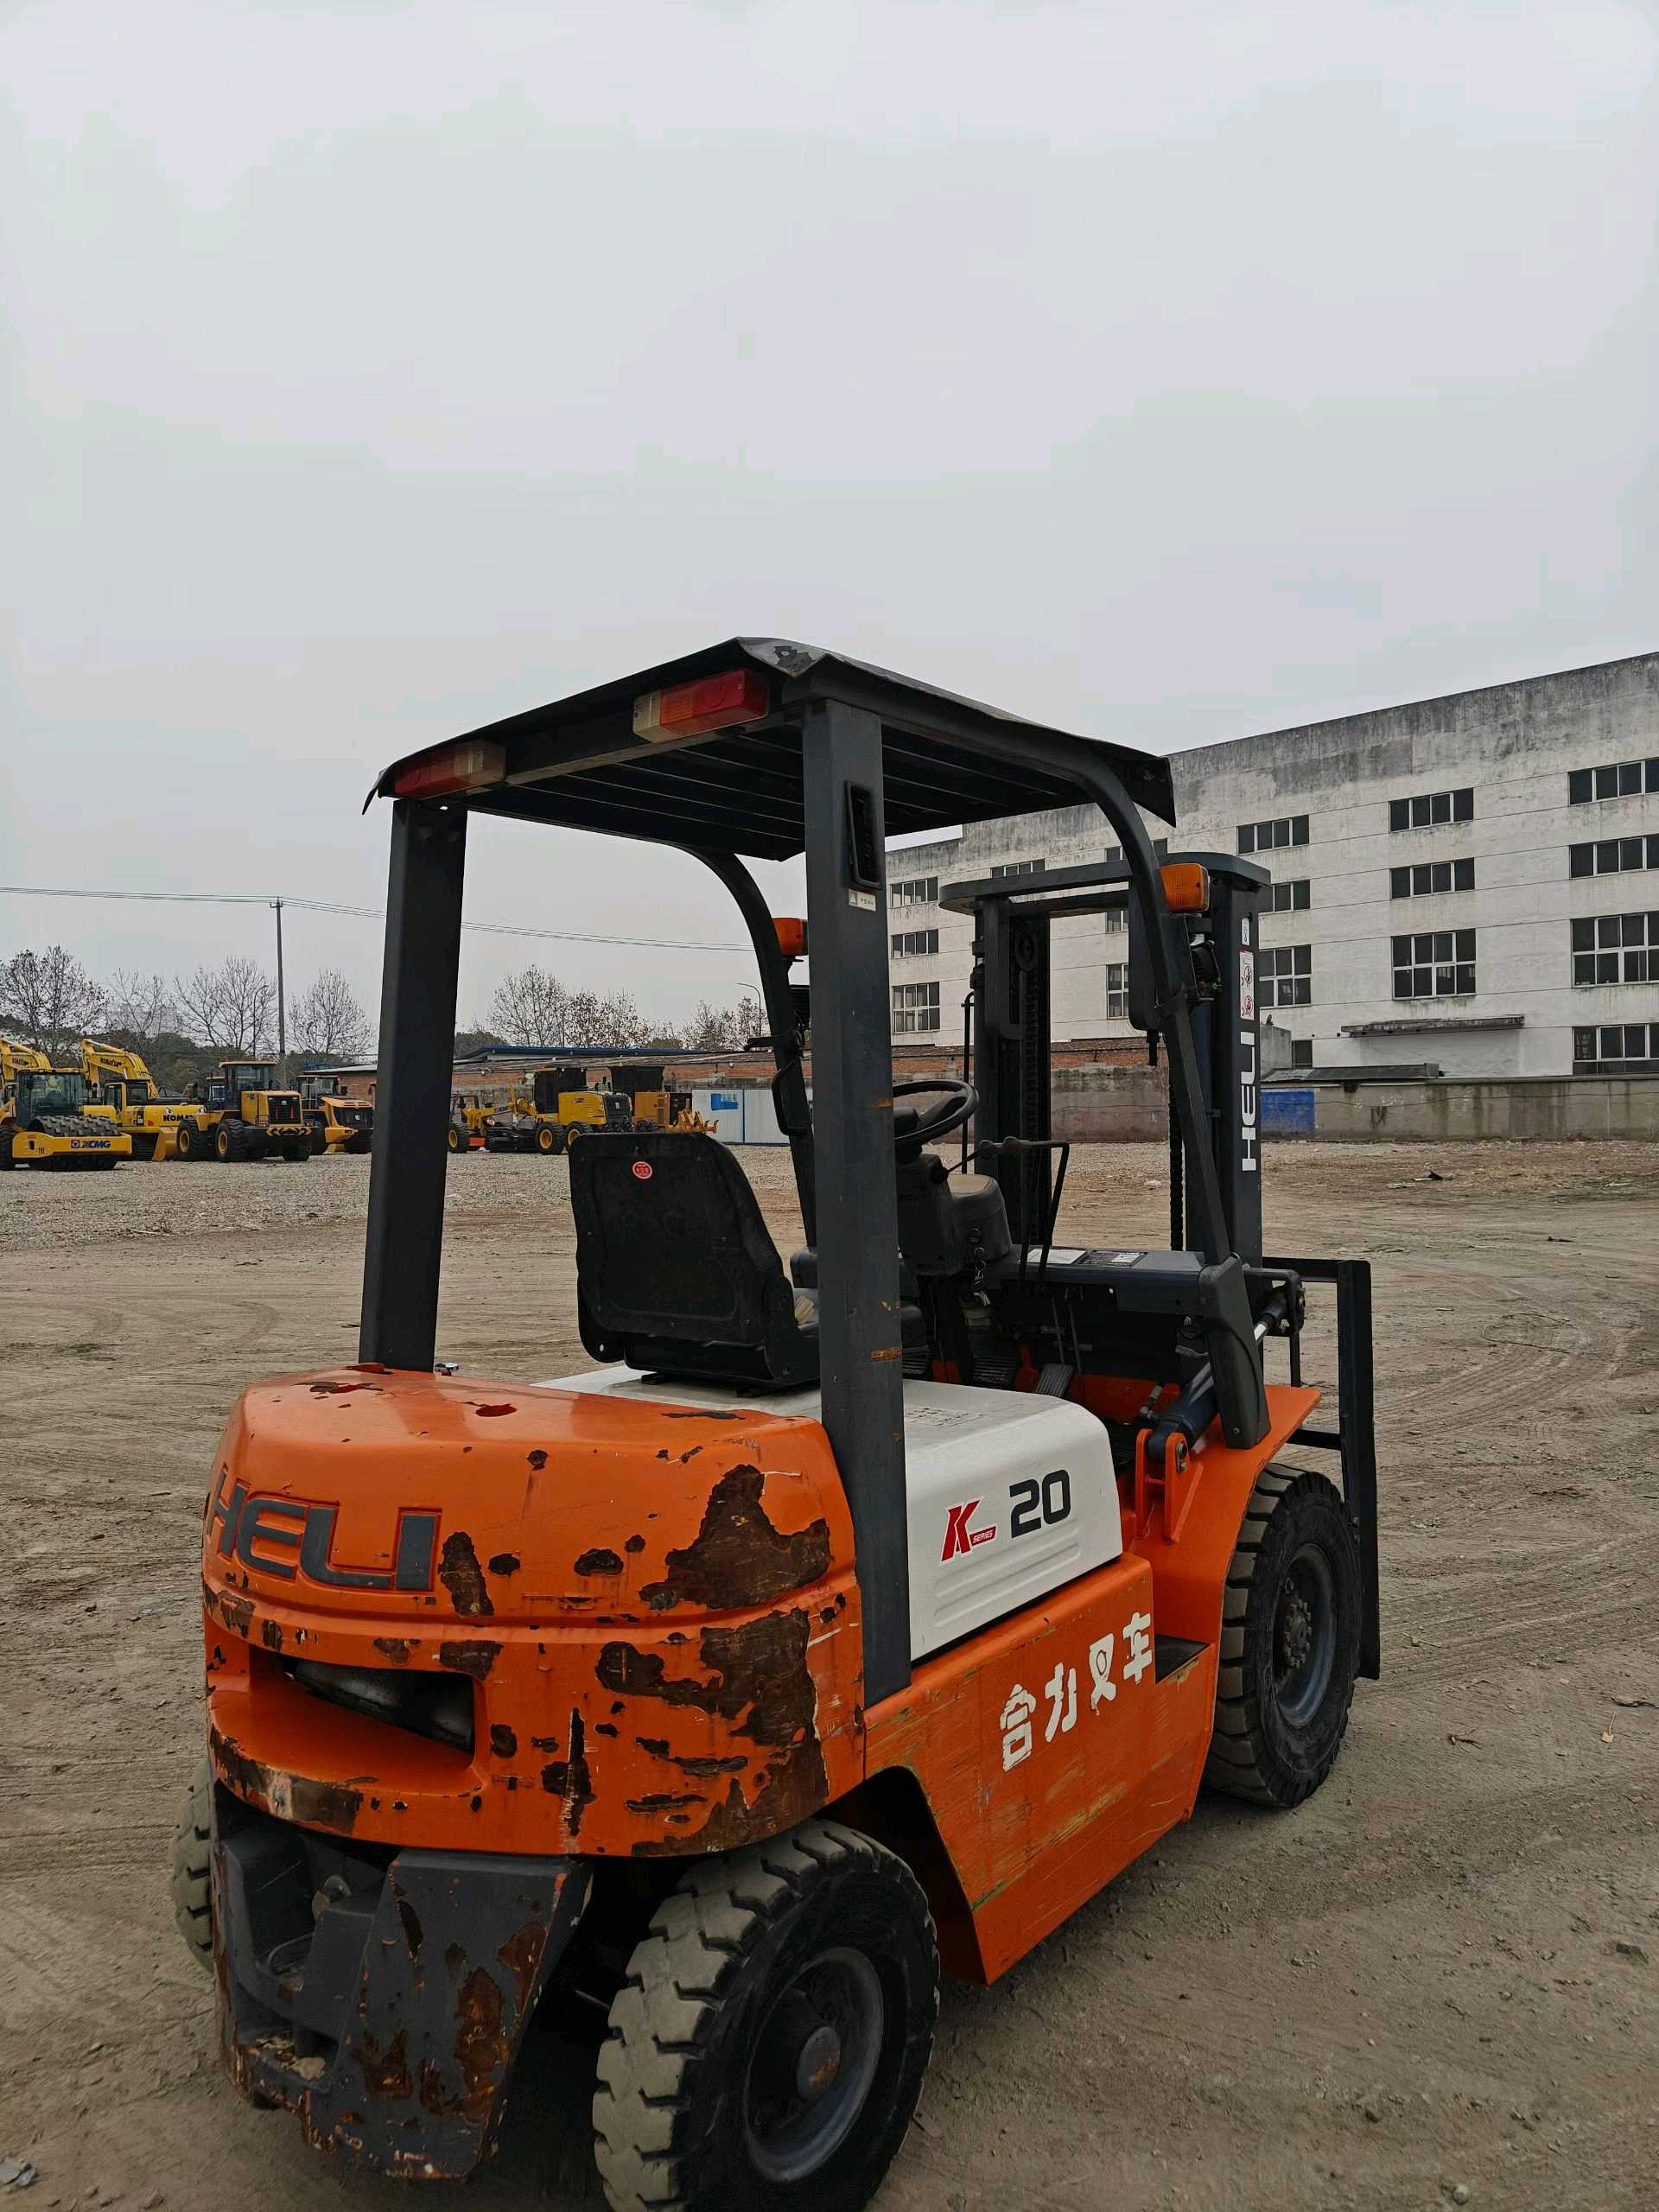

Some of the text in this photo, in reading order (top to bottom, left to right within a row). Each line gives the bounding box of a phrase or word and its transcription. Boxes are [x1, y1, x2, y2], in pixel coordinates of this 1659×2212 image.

[1241, 1032, 1256, 1171] HELI
[206, 1465, 441, 1592] HELI
[940, 1469, 1071, 1563] K SERIES 20
[999, 1611, 1154, 1772] 合力叉车
